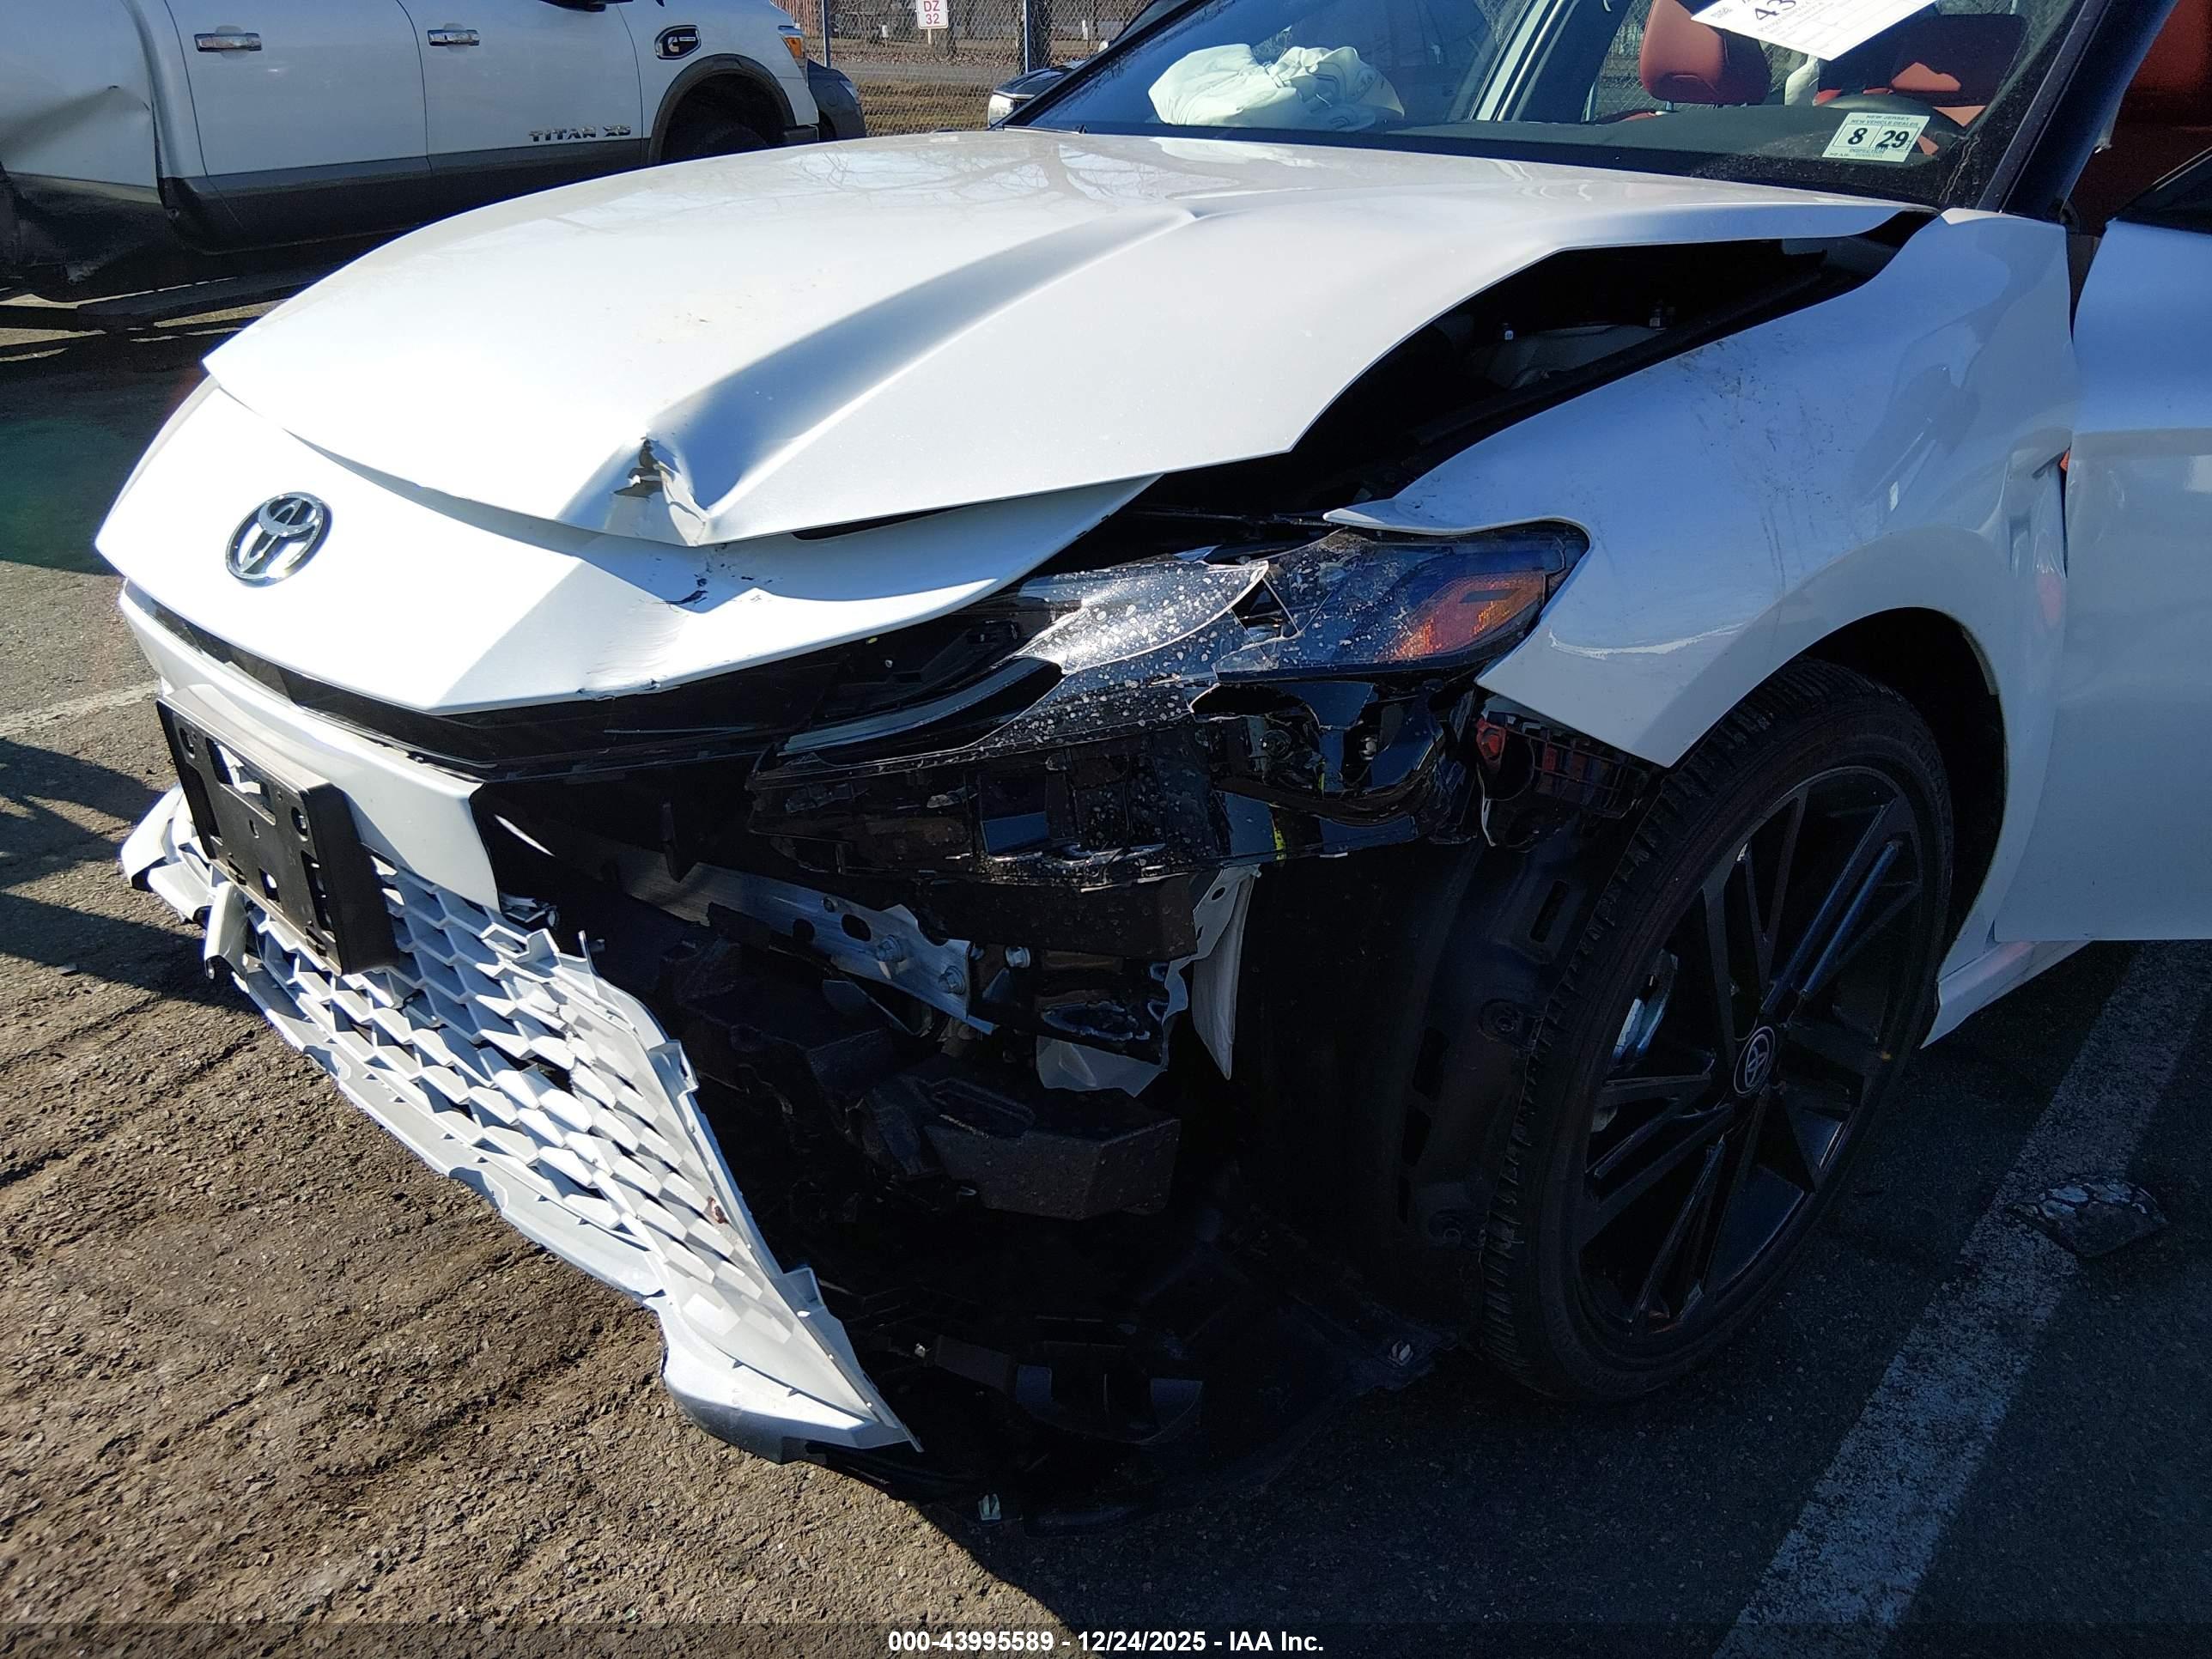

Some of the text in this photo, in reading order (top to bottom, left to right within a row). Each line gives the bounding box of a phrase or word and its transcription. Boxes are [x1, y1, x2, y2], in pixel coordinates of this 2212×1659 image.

[923, 0, 940, 12] DZ
[925, 13, 940, 25] 32
[529, 126, 597, 142] TITAN
[1847, 127, 1910, 149] 8 29
